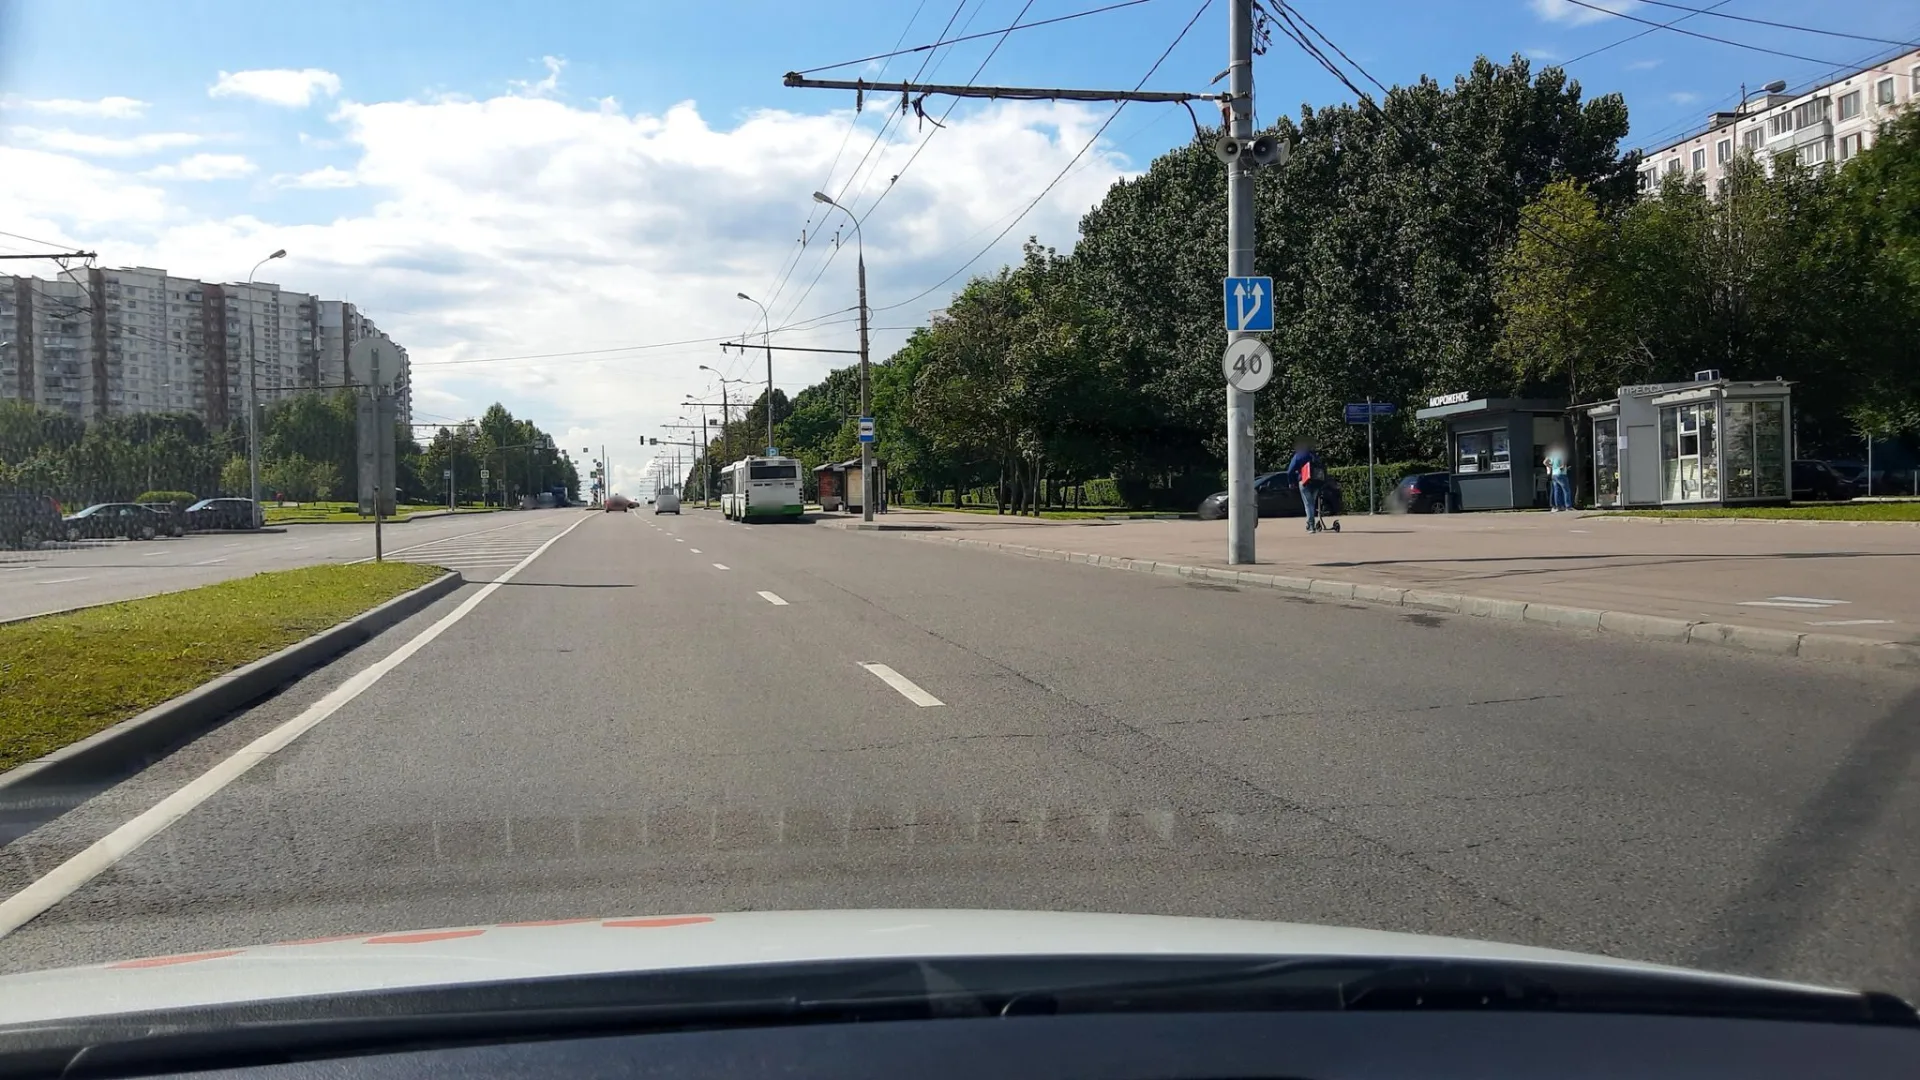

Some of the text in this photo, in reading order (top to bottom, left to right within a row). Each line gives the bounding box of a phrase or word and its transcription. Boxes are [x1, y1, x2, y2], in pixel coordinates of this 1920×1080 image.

[1233, 354, 1262, 375] 40
[1621, 384, 1664, 395] ПРЕССА
[1429, 391, 1469, 407] МОРОЖЕНОЕ
